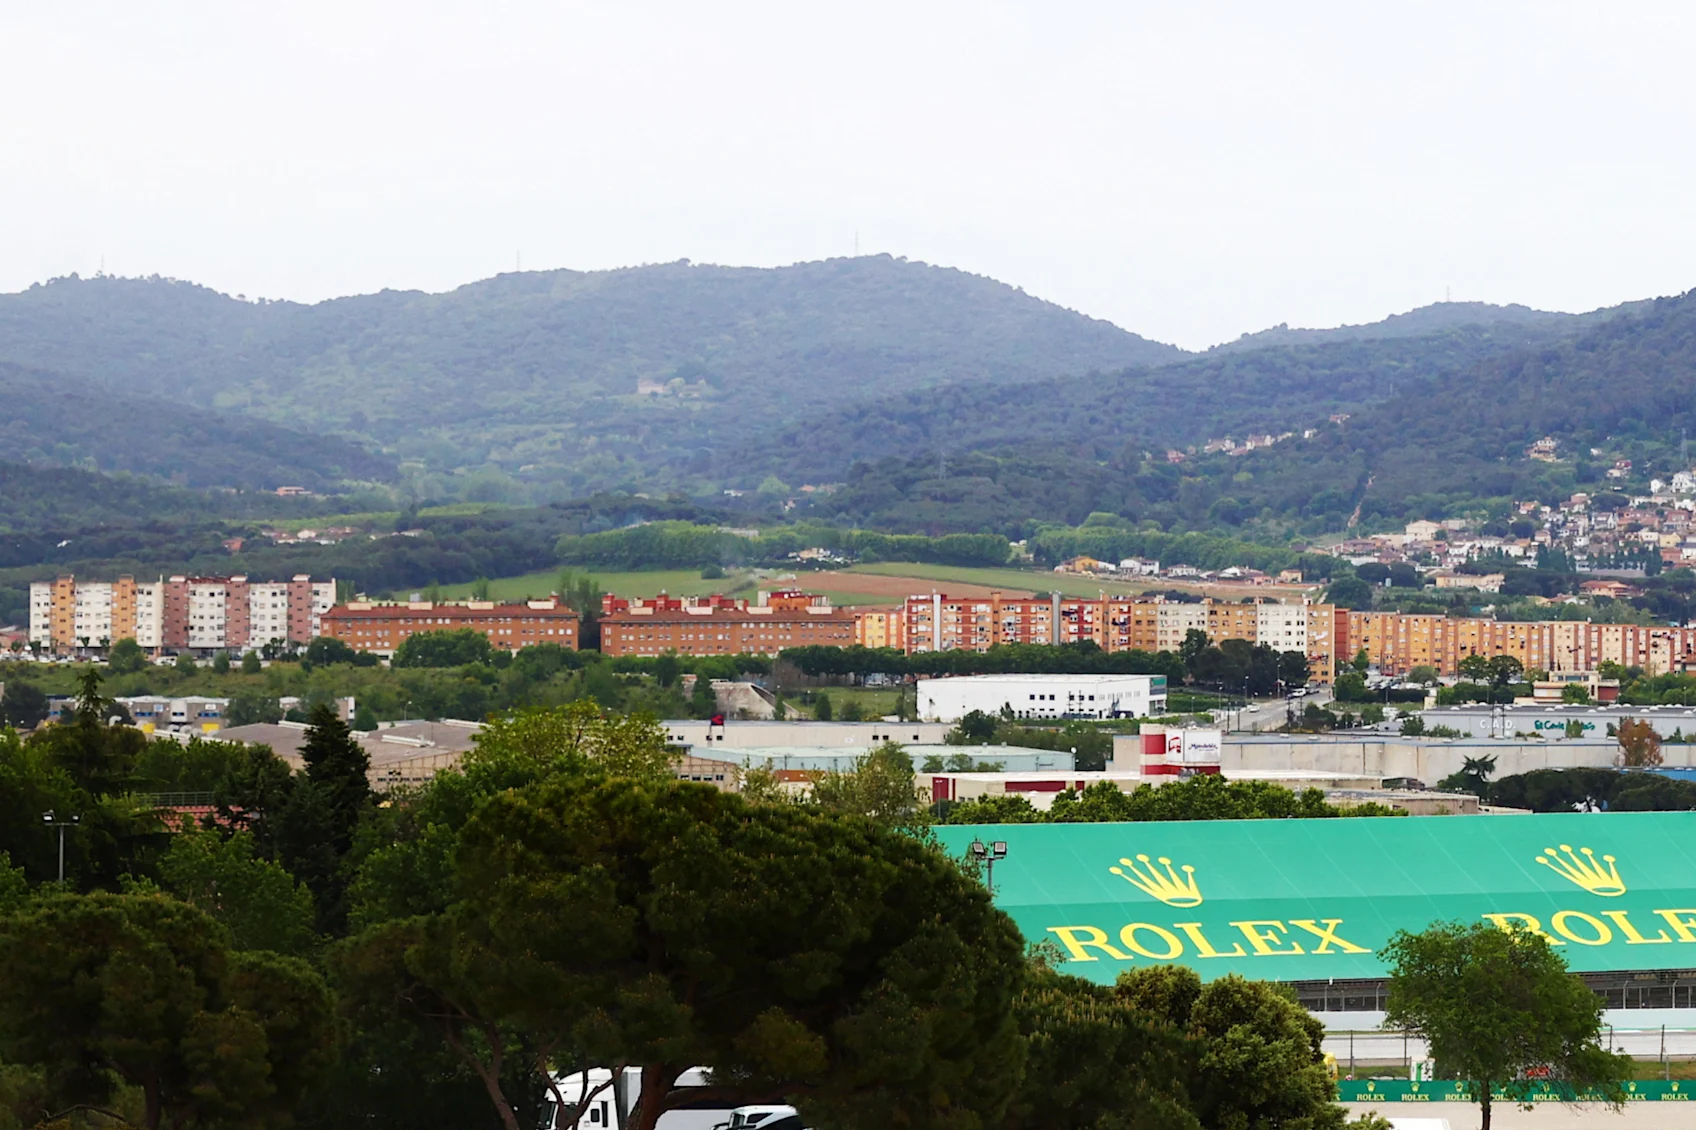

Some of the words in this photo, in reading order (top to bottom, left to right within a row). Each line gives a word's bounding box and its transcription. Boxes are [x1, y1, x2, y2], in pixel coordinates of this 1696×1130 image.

[1046, 918, 1372, 962] ROLEX
[1357, 1093, 1385, 1101] ROLEX
[1401, 1093, 1430, 1101] ROLEX
[1661, 1092, 1689, 1101] ROLEX
